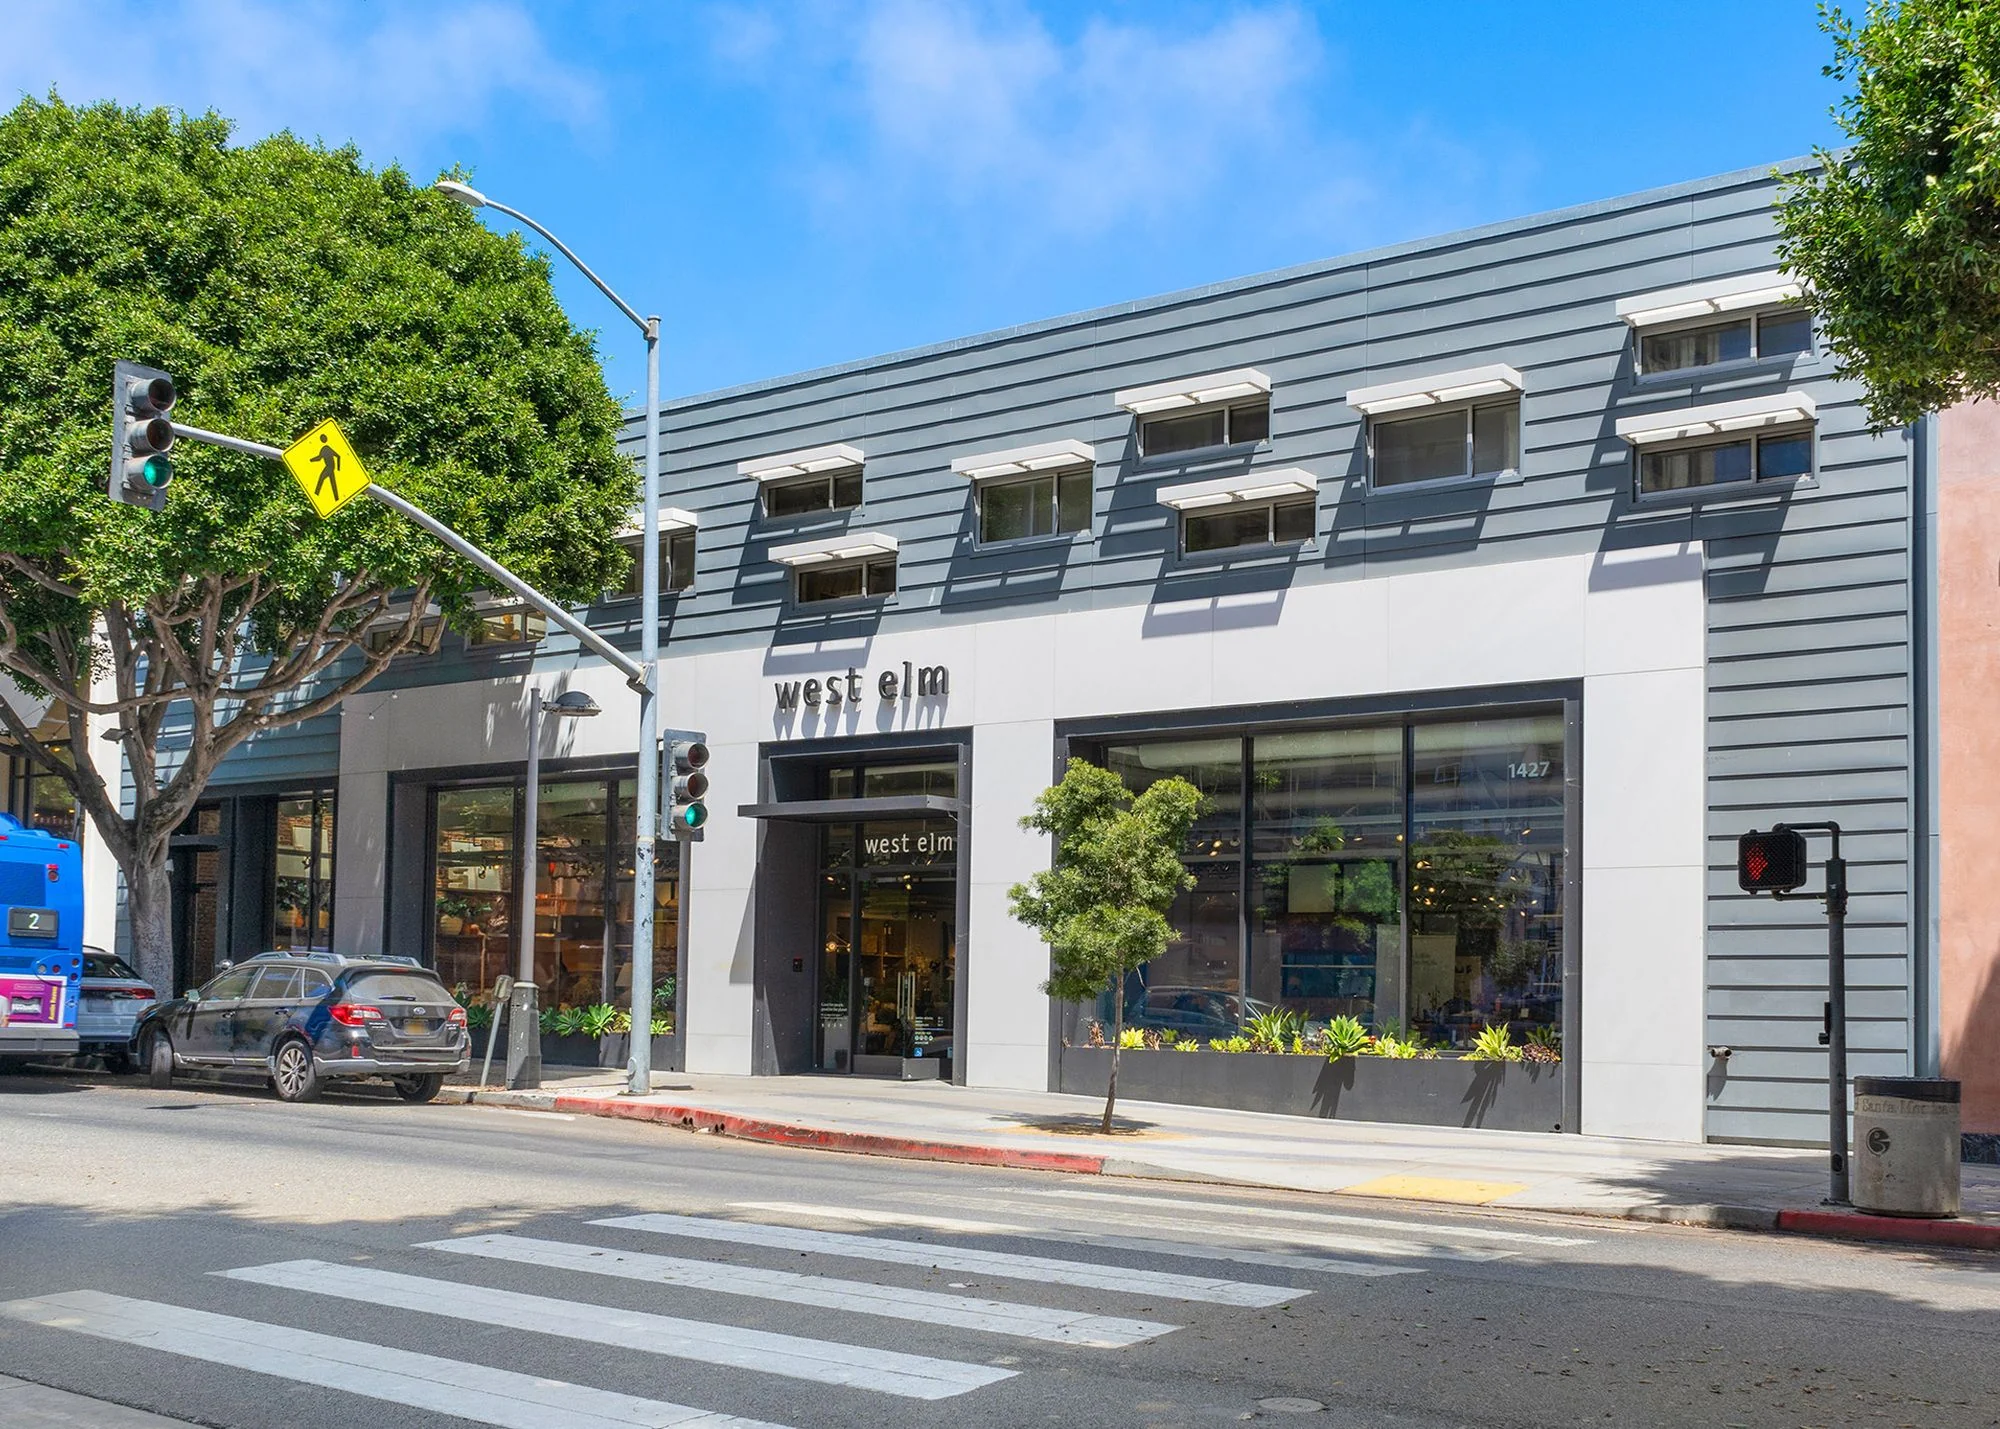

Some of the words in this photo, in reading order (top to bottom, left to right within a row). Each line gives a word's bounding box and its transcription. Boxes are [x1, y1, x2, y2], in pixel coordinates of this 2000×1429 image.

[774, 667, 863, 709] west
[878, 661, 949, 700] elm
[1508, 761, 1550, 778] 1427
[865, 833, 910, 854] west
[917, 832, 953, 852] elm
[29, 912, 40, 930] 2
[1862, 1098, 1894, 1113] Santa
